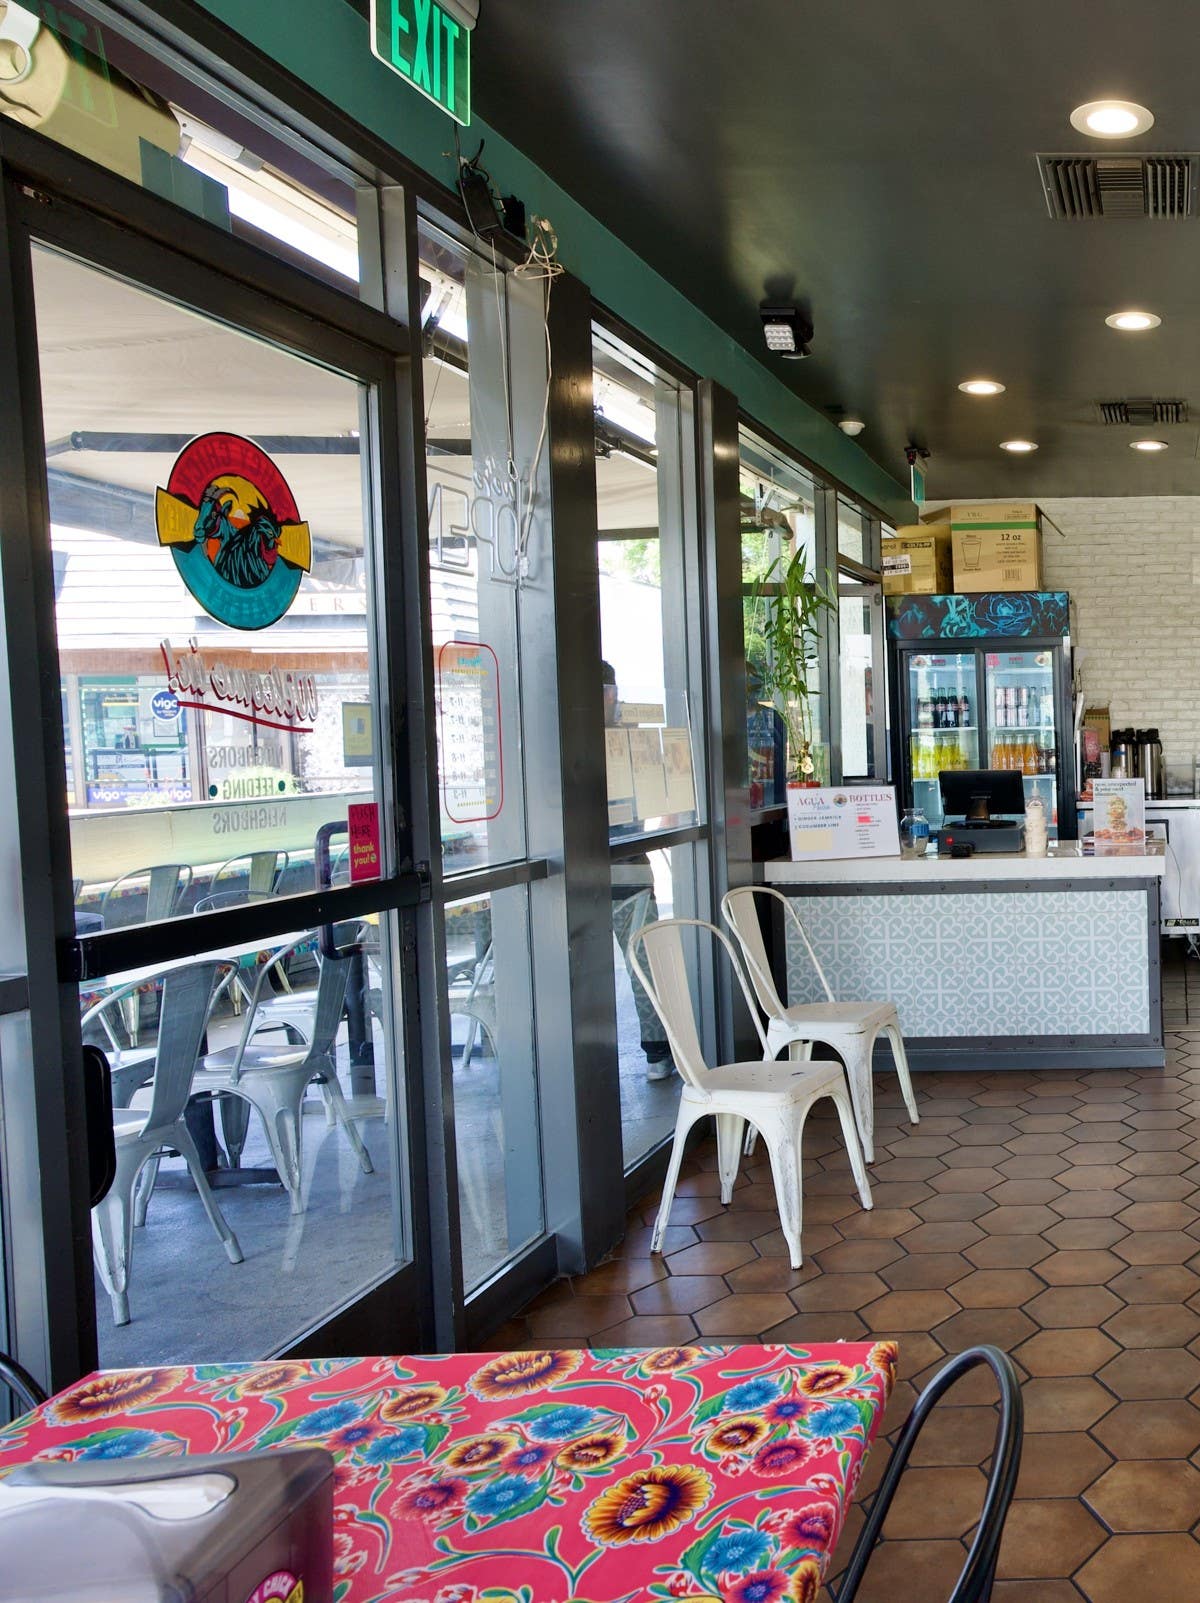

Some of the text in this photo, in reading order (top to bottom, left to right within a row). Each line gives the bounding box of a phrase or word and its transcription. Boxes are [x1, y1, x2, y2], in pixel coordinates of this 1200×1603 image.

[391, 0, 459, 113] EXIT
[93, 790, 119, 801] vigo
[849, 793, 892, 803] BOTTLES
[353, 842, 375, 854] thank
[353, 853, 370, 869] you!
[263, 1575, 293, 1598] CHICK
